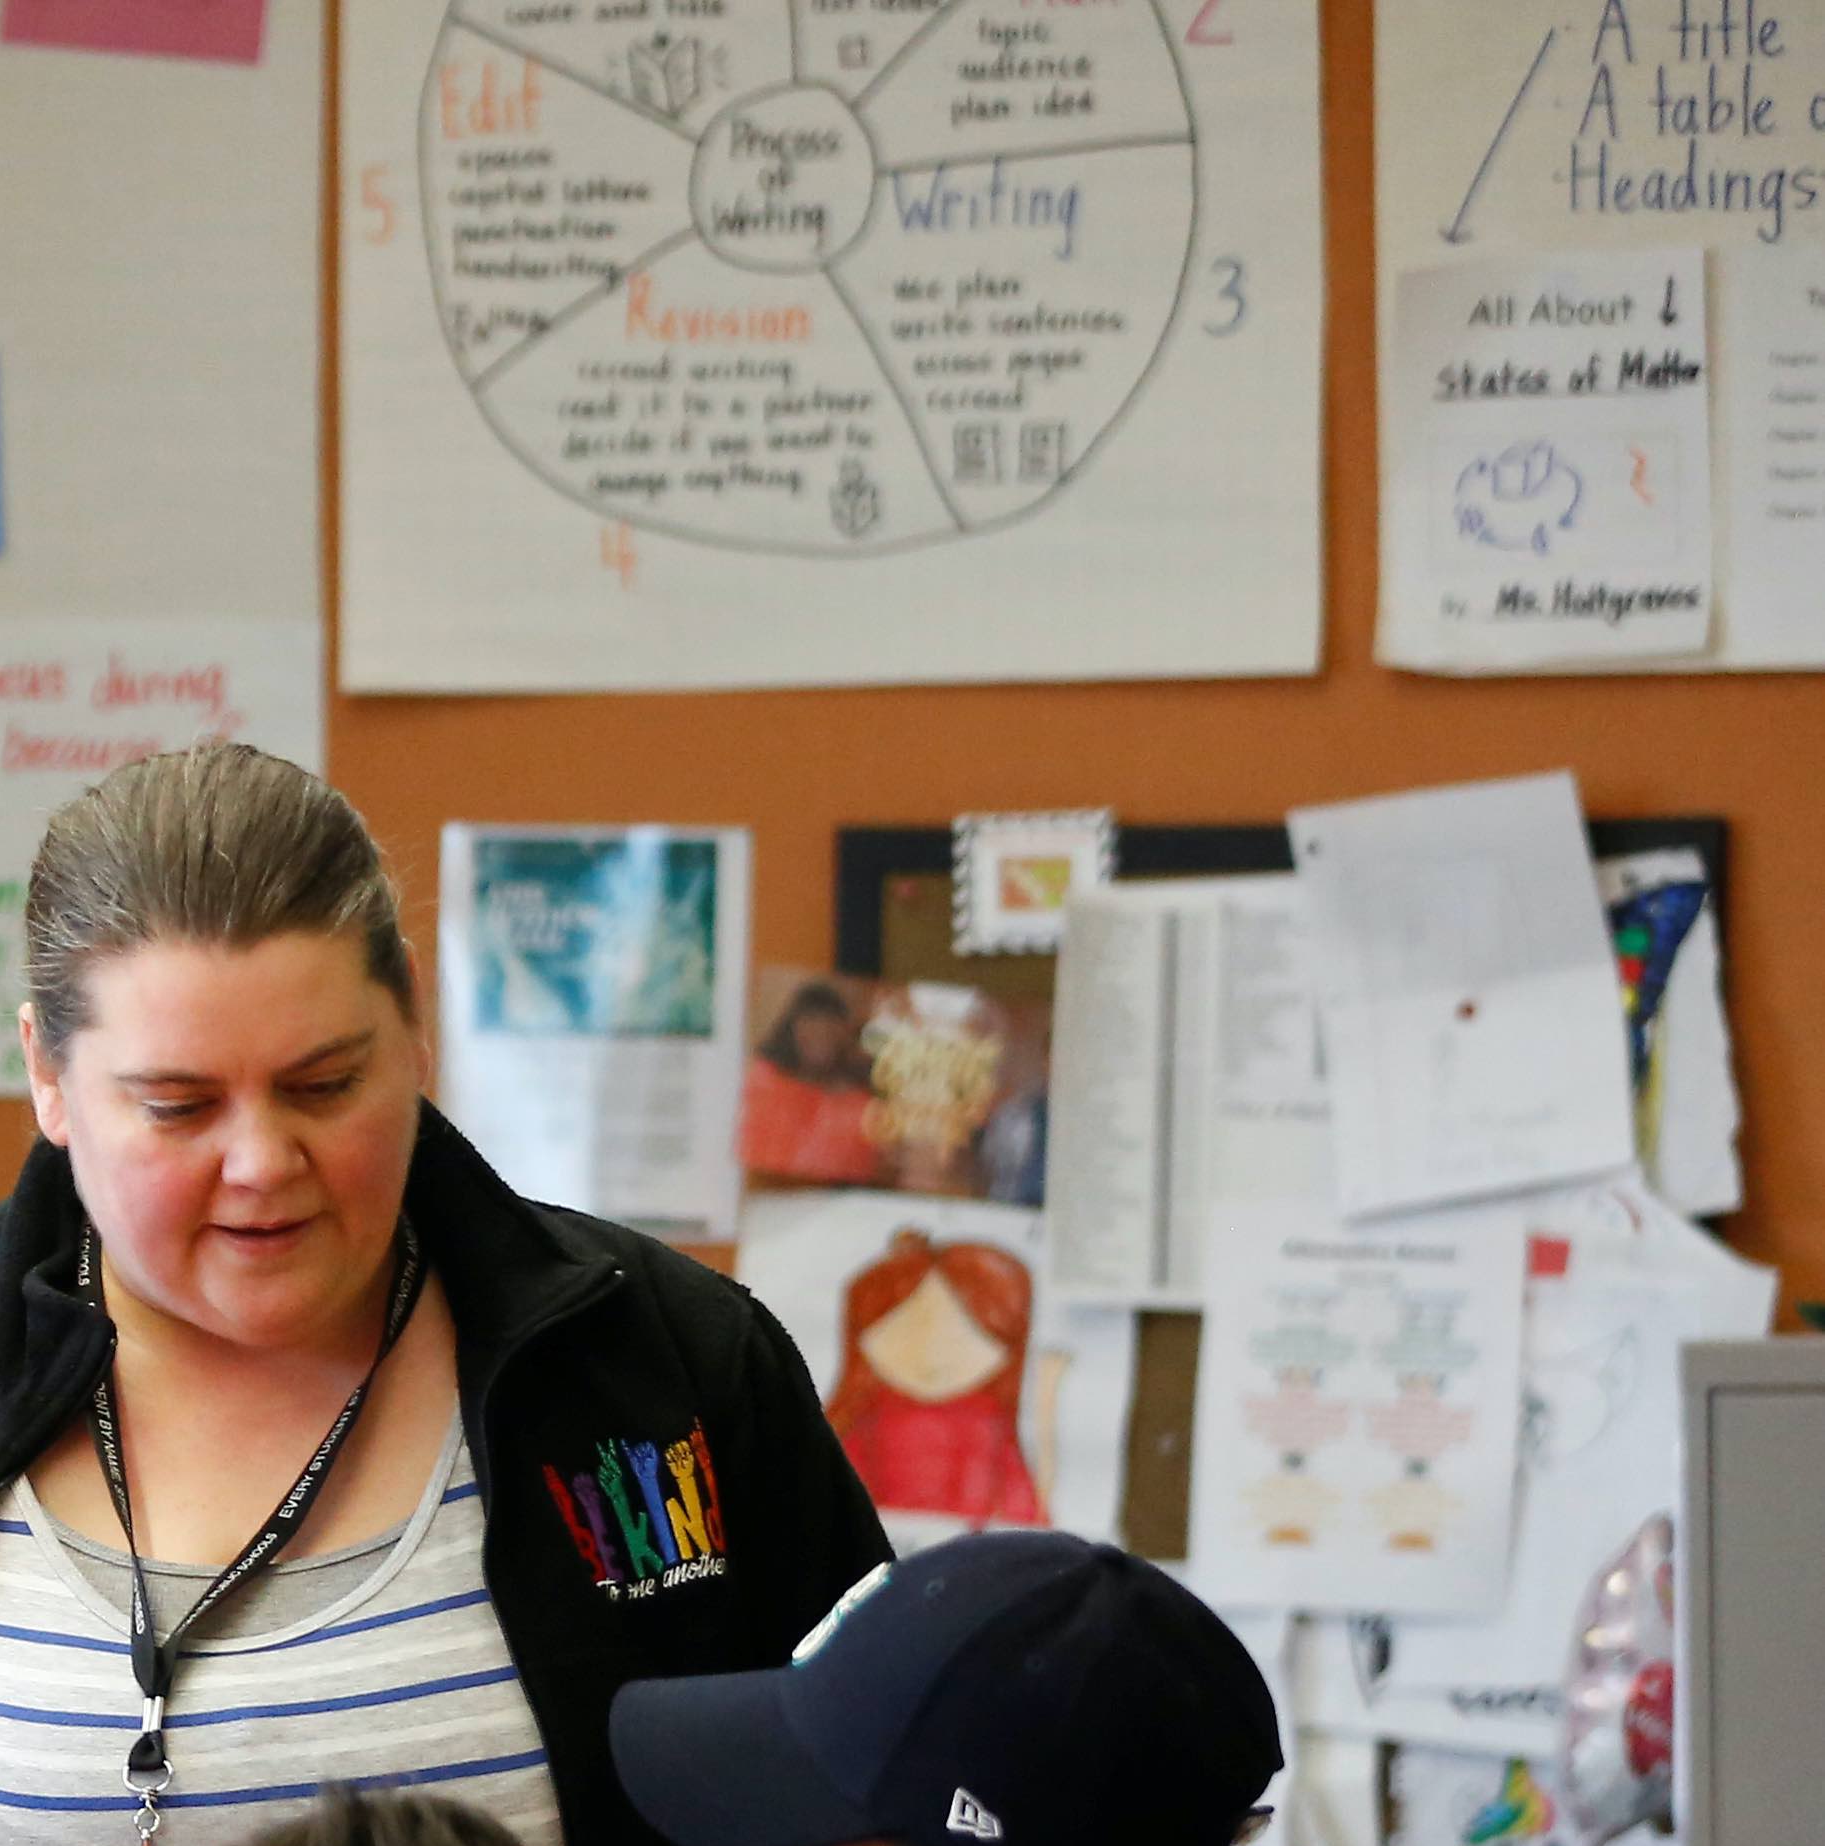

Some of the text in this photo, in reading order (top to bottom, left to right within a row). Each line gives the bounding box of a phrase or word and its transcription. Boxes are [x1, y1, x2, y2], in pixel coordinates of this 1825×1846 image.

[1592, 0, 1785, 63] A title
[439, 50, 543, 139] Edit
[958, 55, 1092, 82] audience
[1578, 63, 1617, 137] A
[1648, 62, 1776, 136] table
[729, 117, 842, 163] Process
[950, 94, 1011, 129] plan
[360, 163, 396, 247] 5
[759, 158, 796, 194] of
[892, 155, 1083, 262] Writing
[1570, 138, 1817, 244] Headings
[711, 198, 827, 250] Writing
[624, 272, 814, 343] Revision
[955, 270, 1021, 310] plan
[1202, 256, 1248, 338] 3
[1468, 293, 1634, 328] All About
[1436, 346, 1701, 397] States of Matter
[598, 520, 637, 591] 4
[92, 648, 228, 722] during
[235, 1533, 278, 1571] SCHOOLS
[278, 1475, 313, 1519] EVERY
[309, 1410, 351, 1472] STUDENT
[663, 1552, 726, 1588] anothe
